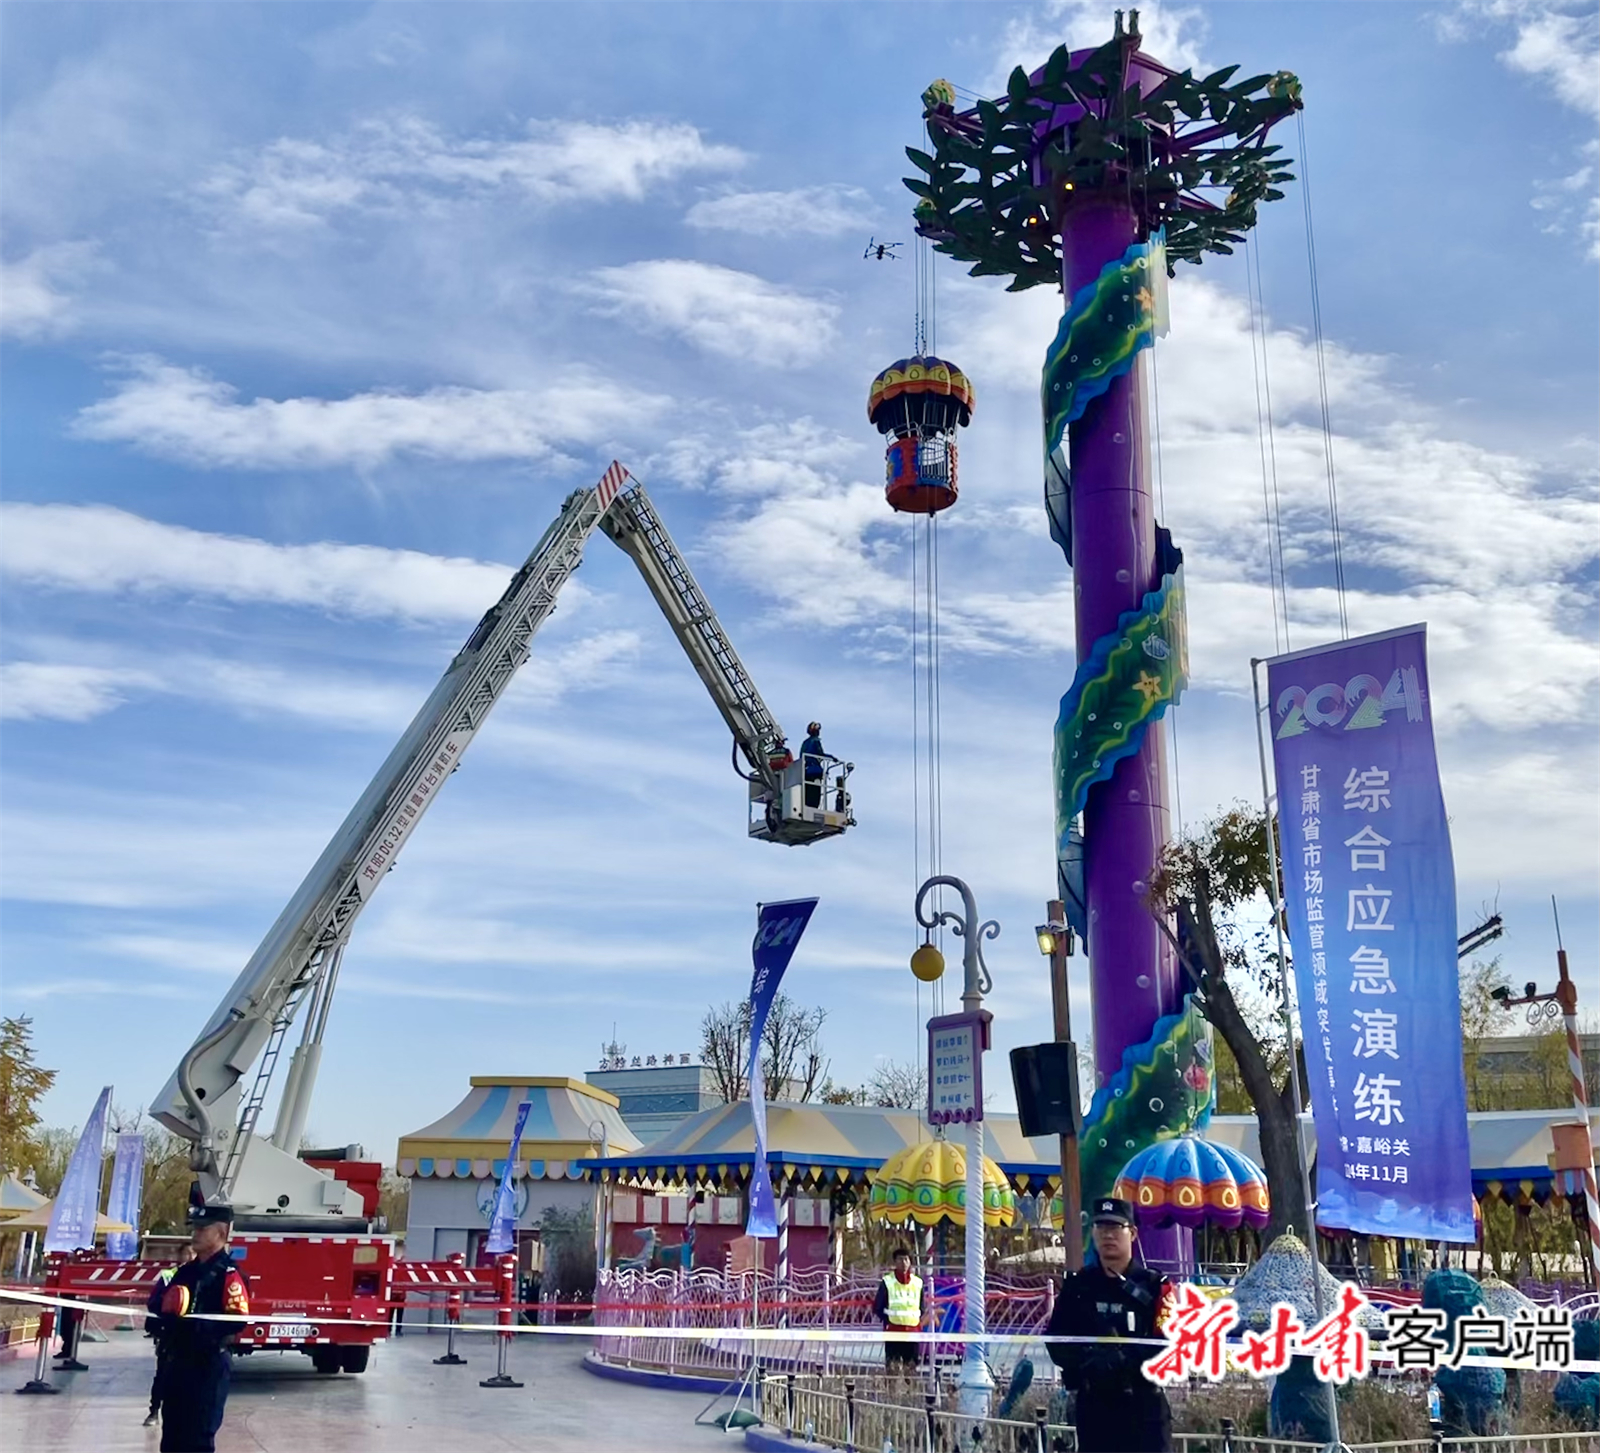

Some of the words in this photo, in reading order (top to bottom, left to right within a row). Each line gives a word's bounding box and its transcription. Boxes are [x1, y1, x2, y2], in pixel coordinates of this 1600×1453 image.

[1275, 664, 1424, 740] 2024
[1343, 766, 1405, 1126] 综合应急演练
